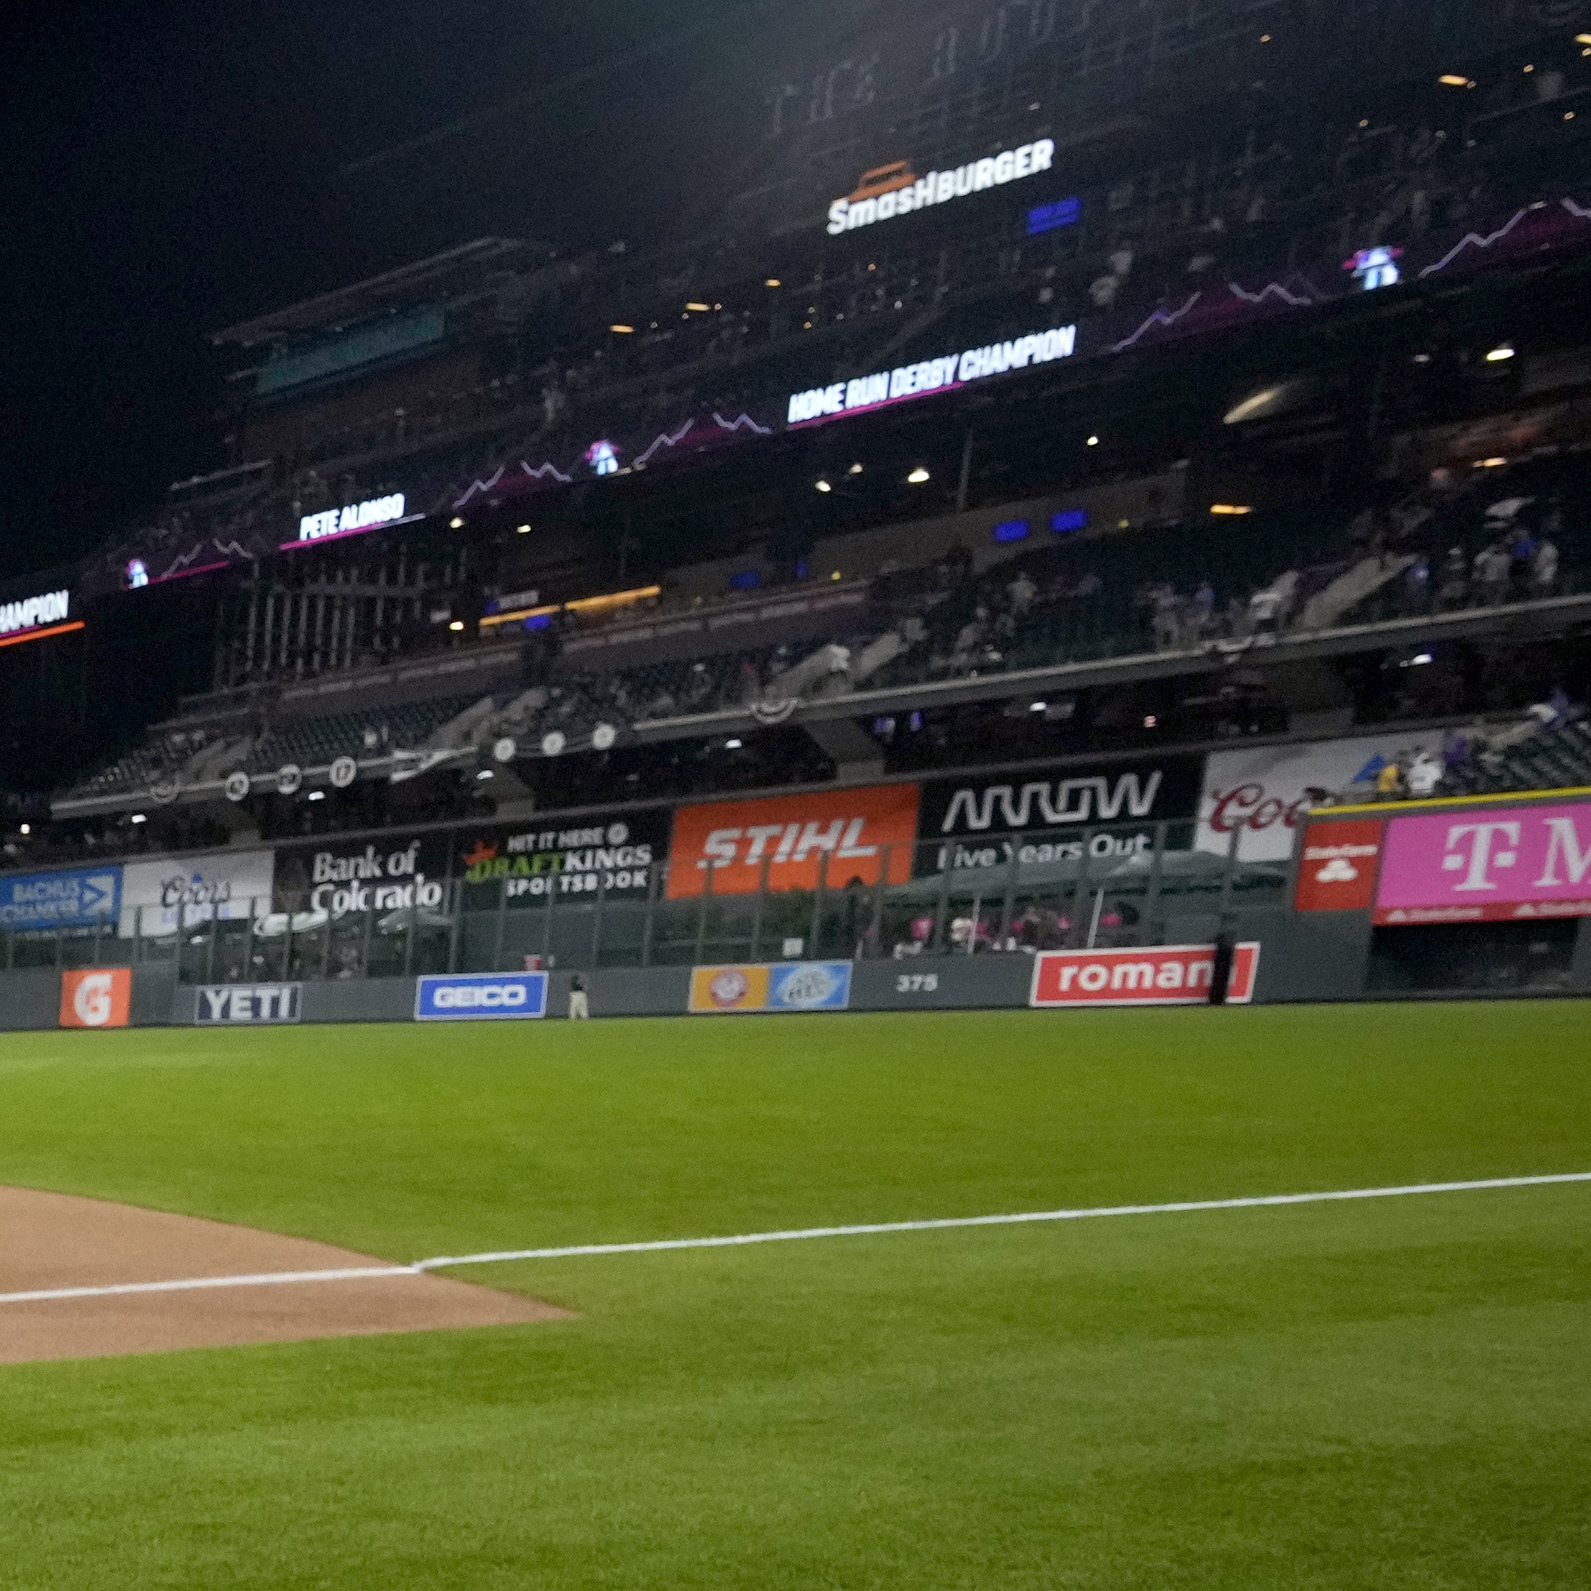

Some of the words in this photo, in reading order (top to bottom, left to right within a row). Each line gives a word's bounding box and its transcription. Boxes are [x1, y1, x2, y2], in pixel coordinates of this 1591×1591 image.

[787, 382, 847, 424] HOME
[845, 371, 891, 409] RUN
[888, 354, 961, 397] DERBY
[958, 324, 1077, 382] CHAMPION
[299, 507, 341, 541] PETE
[339, 492, 406, 532] ALONSO
[941, 770, 1163, 833] ARROW
[1210, 783, 1303, 833] Coo
[313, 846, 384, 883] Bank
[387, 840, 422, 877] of
[697, 817, 877, 869] STIHL
[507, 870, 647, 897] SPOTSBOK
[74, 973, 115, 1027] G
[433, 983, 527, 1009] GEICO
[1060, 958, 1216, 993] roman
[203, 987, 291, 1021] YETI
